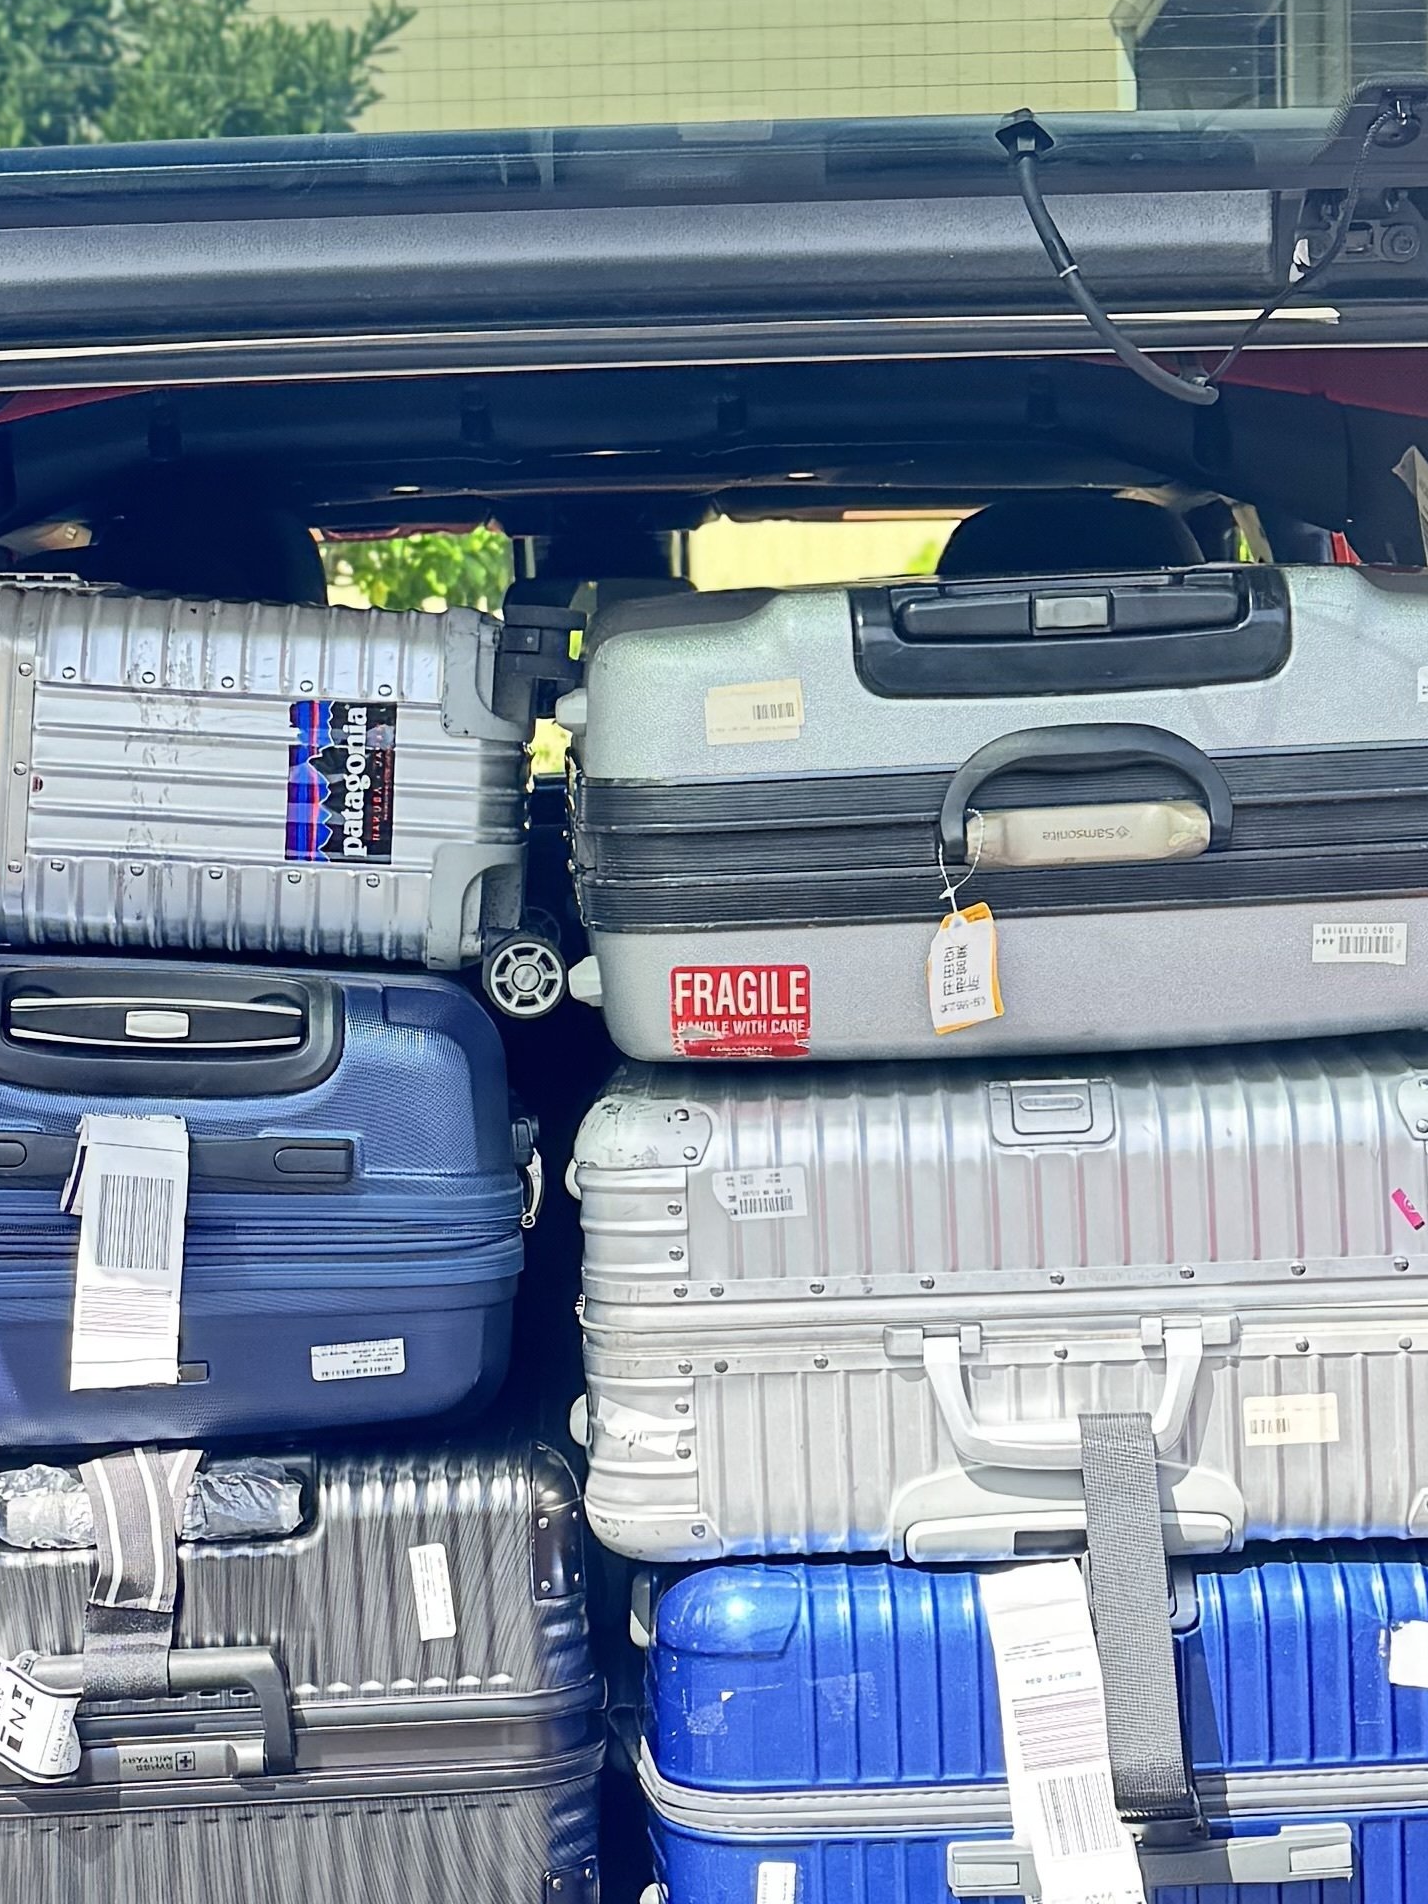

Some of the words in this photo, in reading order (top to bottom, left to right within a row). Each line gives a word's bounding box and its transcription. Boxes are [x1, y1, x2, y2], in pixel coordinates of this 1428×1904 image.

[340, 706, 369, 858] patagonia
[1042, 827, 1115, 842] Samsonite
[674, 970, 807, 1017] FRAGILE
[676, 1019, 730, 1036] HANDLE
[732, 1019, 768, 1035] WITH
[771, 1018, 806, 1034] CARE
